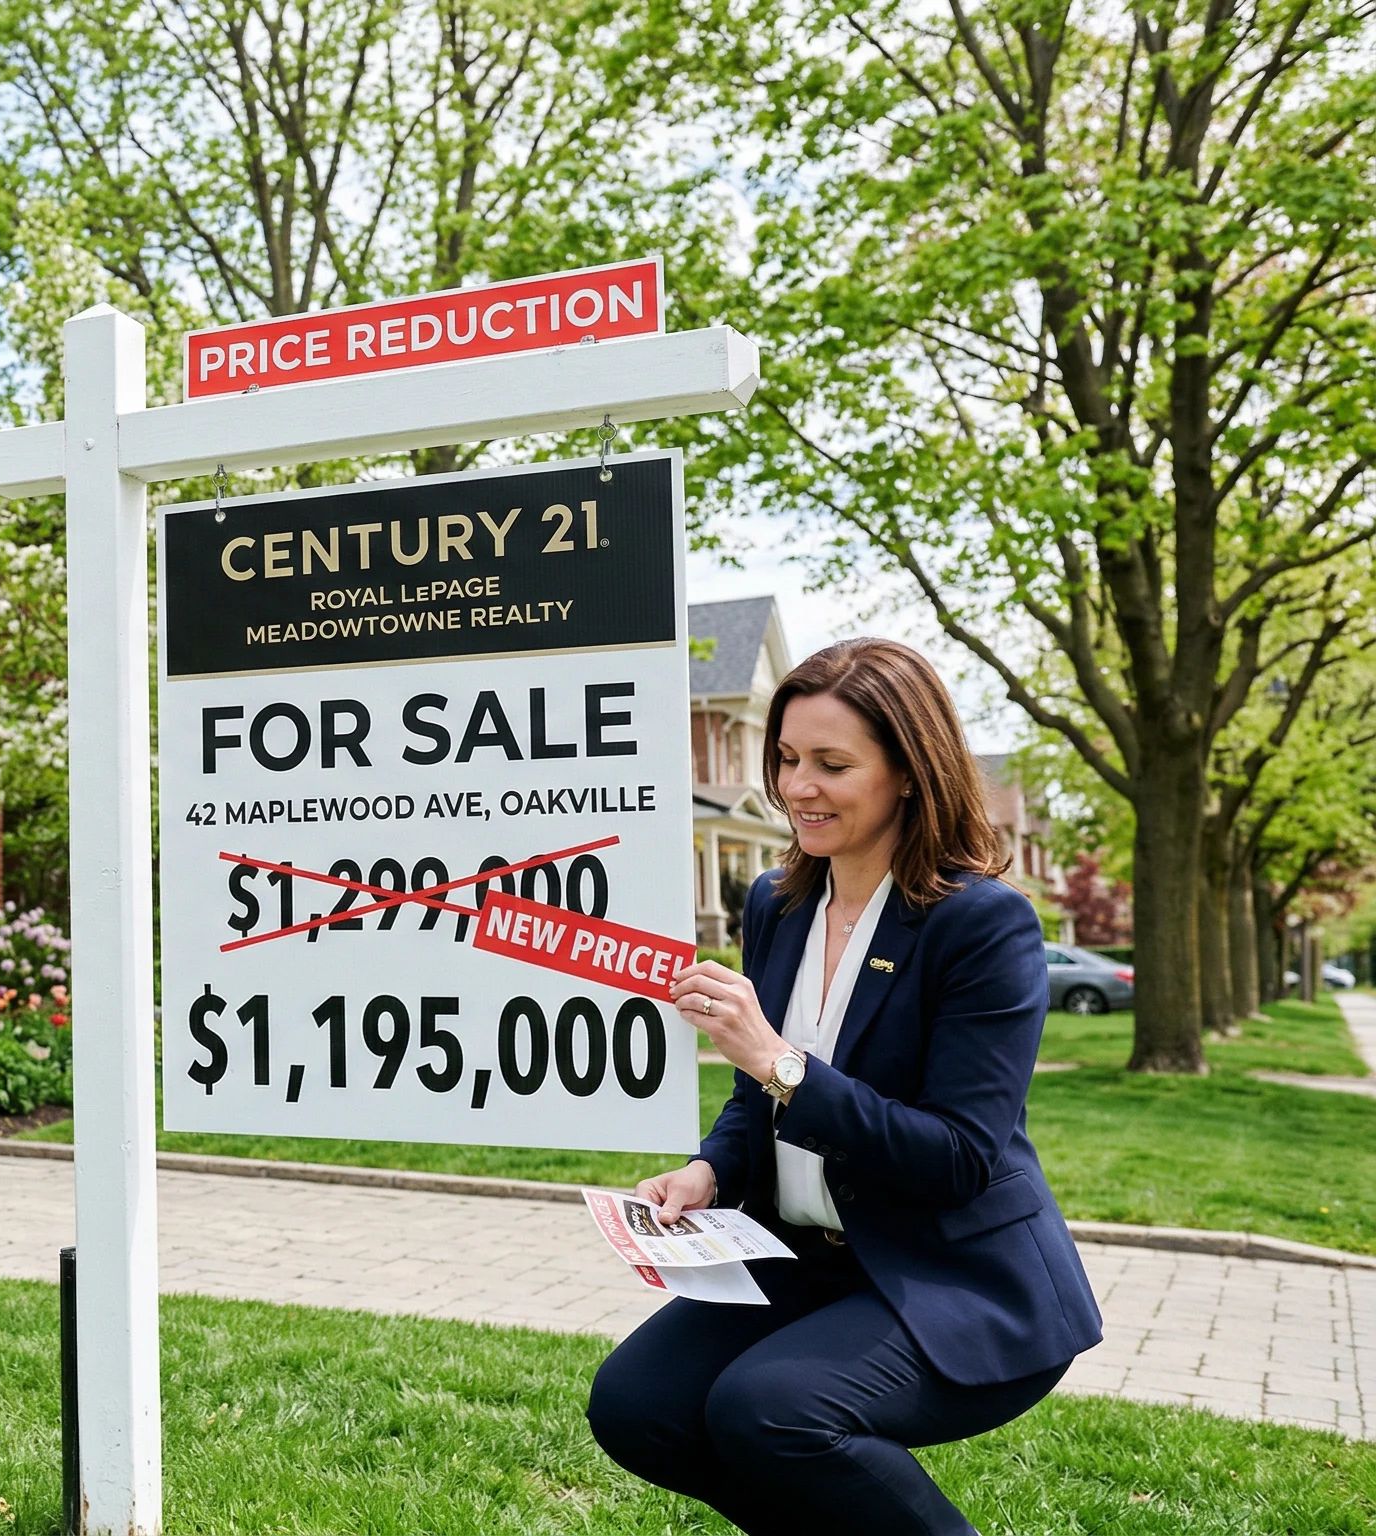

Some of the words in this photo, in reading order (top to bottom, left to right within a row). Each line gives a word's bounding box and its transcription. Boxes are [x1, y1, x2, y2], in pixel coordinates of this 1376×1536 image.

[200, 328, 331, 382] PRICE
[347, 280, 643, 361] REDUCTION
[221, 507, 523, 582] CENTURY
[246, 609, 462, 645] MEADOWTOWNE
[470, 599, 574, 628] REALTY
[310, 585, 394, 611] ROYAL
[202, 698, 373, 775] FOR
[401, 681, 638, 766] SALE
[185, 802, 217, 826] 42
[225, 795, 415, 825] MAPLEWOOD
[423, 791, 491, 822] AVE,
[500, 785, 656, 816] OAKVILLE
[485, 905, 567, 954] NEW
[569, 928, 684, 988] PRICE!
[187, 983, 667, 1110] $1,195,000
